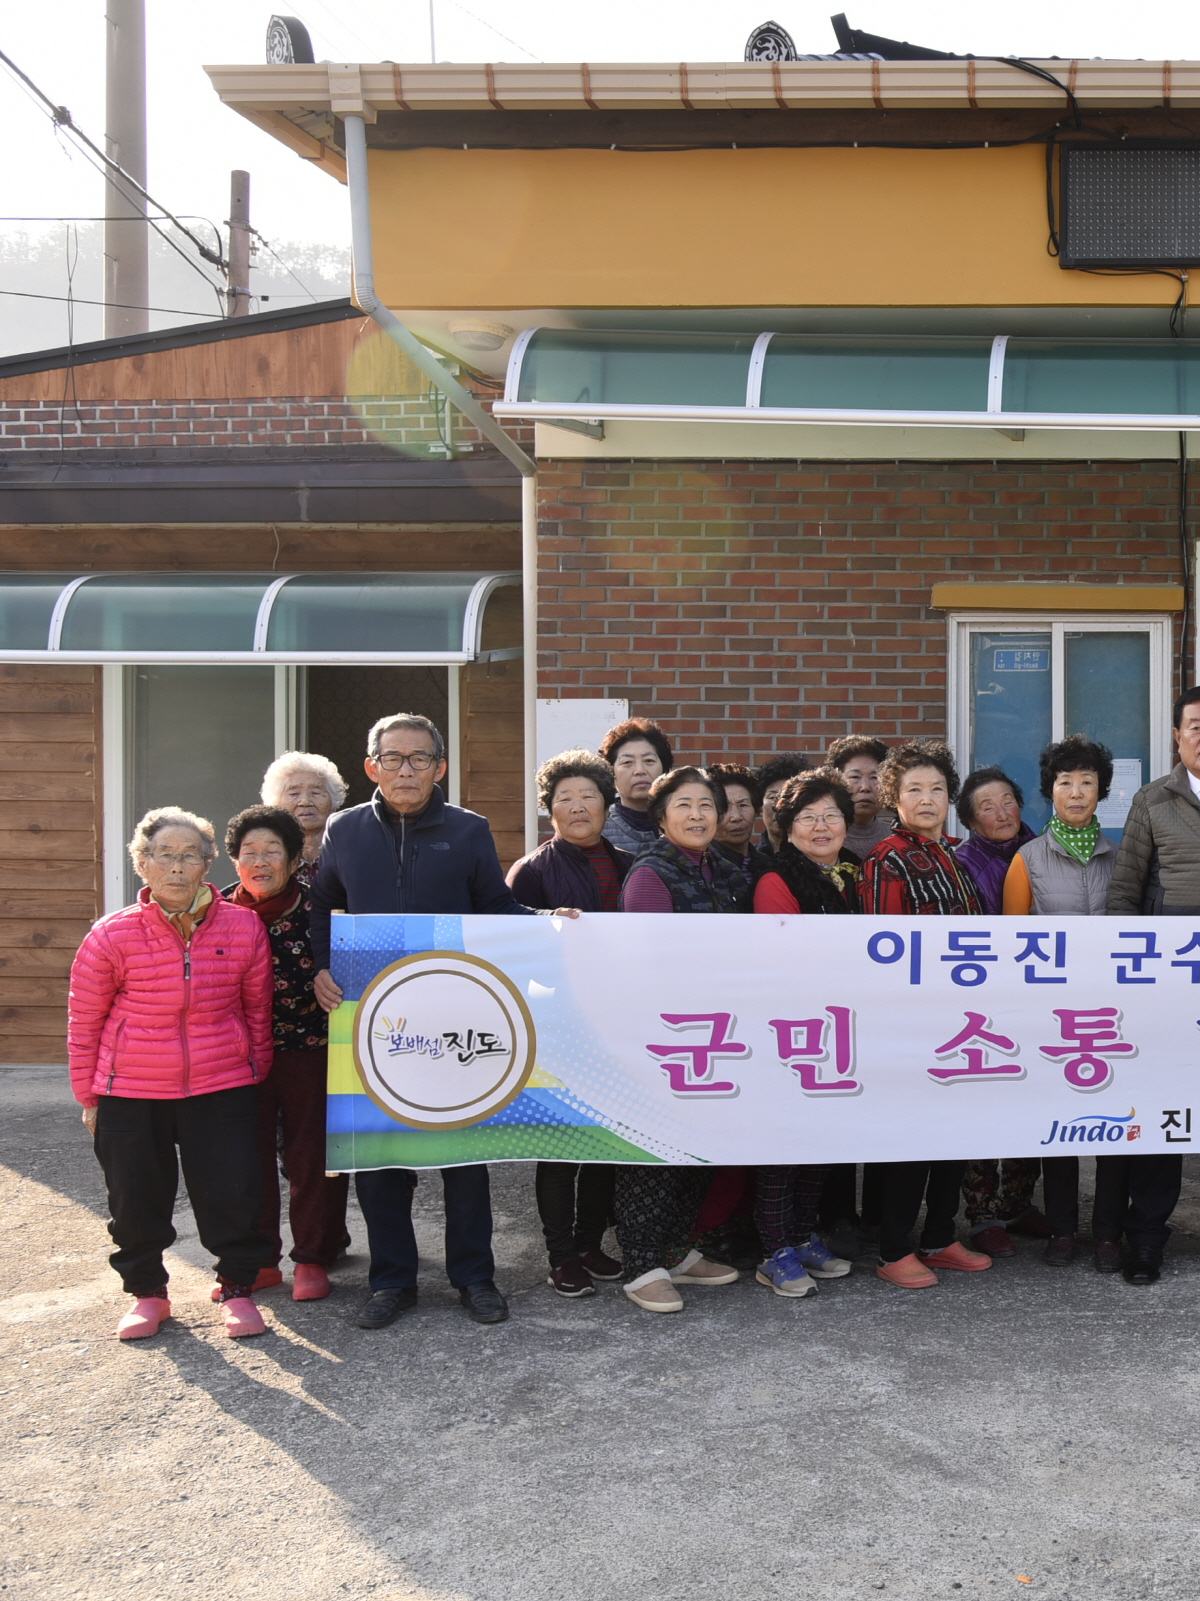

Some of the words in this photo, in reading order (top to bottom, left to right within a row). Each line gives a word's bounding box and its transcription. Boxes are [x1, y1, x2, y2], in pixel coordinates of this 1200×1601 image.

[866, 930, 1068, 987] 이동진
[387, 1034, 440, 1056] 보배섬
[442, 1028, 507, 1063] 진도
[644, 1004, 859, 1093] 군민
[925, 1006, 1135, 1088] 소통
[1040, 1119, 1124, 1145] Jindo
